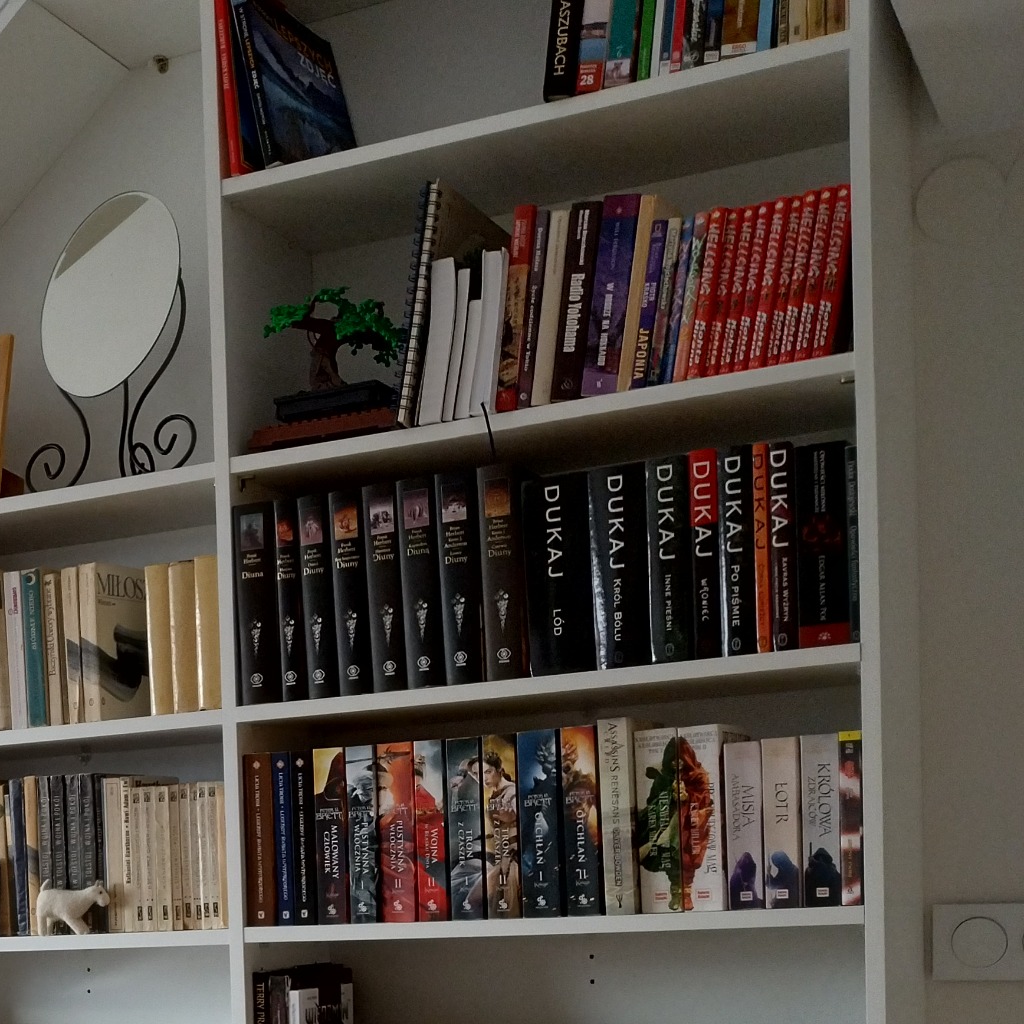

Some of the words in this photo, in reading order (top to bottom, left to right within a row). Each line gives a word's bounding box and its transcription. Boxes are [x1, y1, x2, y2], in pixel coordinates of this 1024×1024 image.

[251, 70, 260, 90] ZDJĘĆ
[580, 74, 594, 85] 28
[569, 273, 585, 302] Radio
[607, 282, 614, 291] W
[563, 302, 581, 353] Yokohama
[633, 328, 650, 380] JAPONIA
[657, 464, 677, 560] DUKAJ
[693, 461, 713, 558] DUKAJ
[724, 456, 743, 553] DUKAJ
[753, 454, 764, 550] DUKAJ
[770, 449, 789, 548] DUKAJ
[544, 485, 564, 578] DUKAJ
[607, 475, 625, 569] DUKAJ
[303, 567, 324, 577] Diuny
[336, 560, 359, 570] Diuny
[373, 552, 394, 562] Diuny
[445, 555, 468, 565] Diuny
[488, 548, 512, 558] Diuny
[731, 565, 740, 582] PO
[97, 572, 145, 600] MIŁOS
[241, 571, 264, 580] Diuna
[277, 571, 296, 580] Diuny
[613, 579, 621, 607] KRÓL
[665, 599, 673, 631] PIEŚNI
[701, 578, 710, 622] WRONIEC
[732, 585, 740, 627] PIŚMIE
[613, 612, 622, 641] BÓLU
[611, 775, 620, 824] RENESANS
[732, 773, 740, 841] AMBASADORA
[742, 785, 754, 827] MISJA
[775, 783, 788, 824] ŁOTR
[818, 763, 831, 837] KRÓLOWA
[323, 831, 331, 874] CZŁOWIEK
[330, 824, 340, 879] MALOWANY
[396, 820, 404, 873] PUSTYNNA
[464, 829, 473, 858] TRON
[501, 827, 510, 857] TRON
[534, 812, 544, 865] OTCHŁAŃ
[576, 810, 586, 863] OTCHŁAŃ
[257, 982, 266, 1010] TERRY
